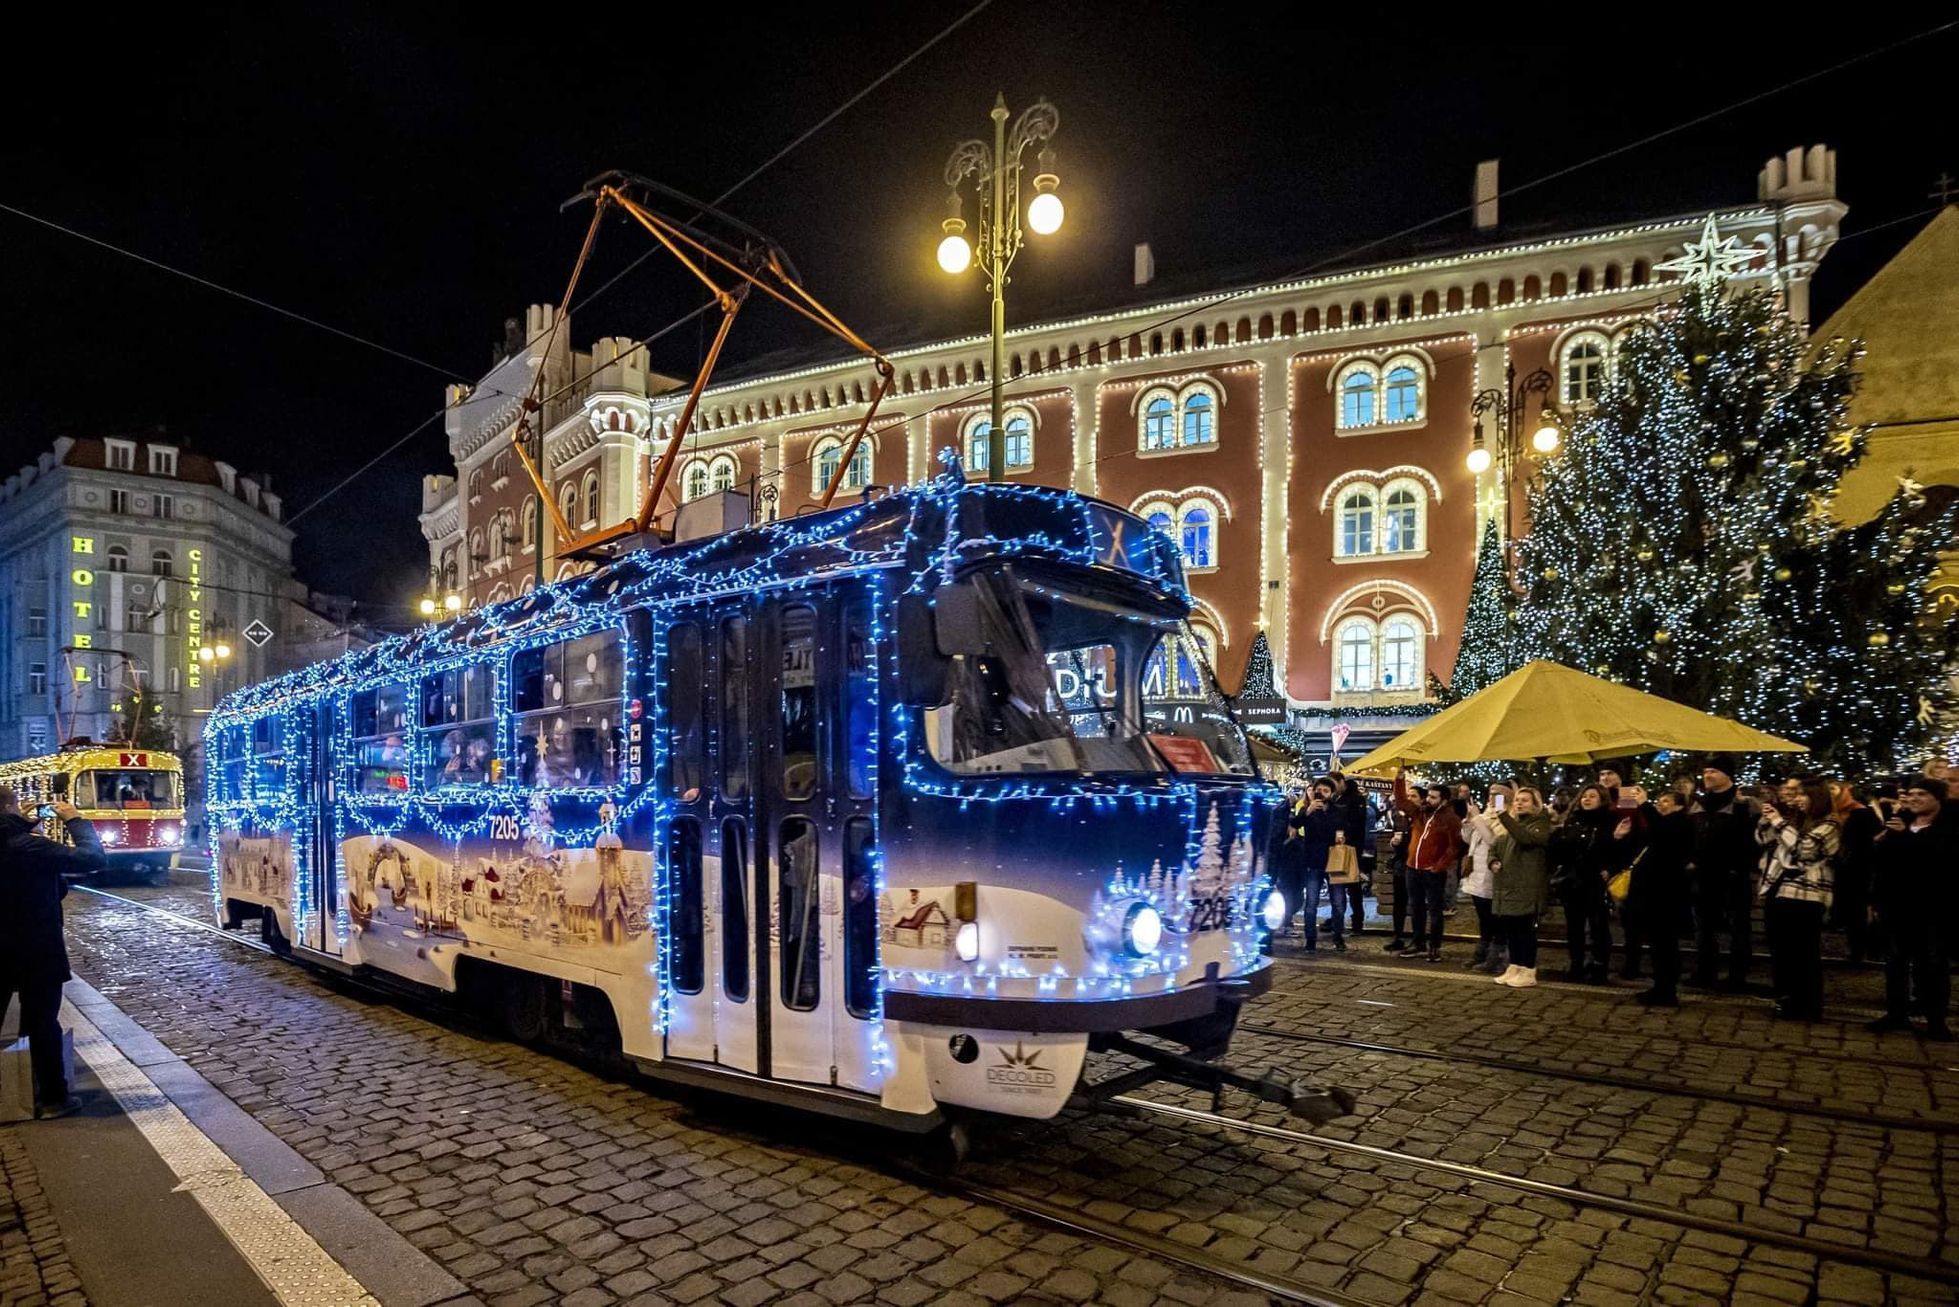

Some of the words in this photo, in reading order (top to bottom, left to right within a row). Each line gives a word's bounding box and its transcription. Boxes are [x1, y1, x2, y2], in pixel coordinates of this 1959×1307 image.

[188, 550, 201, 601] CITY
[72, 536, 94, 682] HOTEL
[188, 609, 201, 688] CENTRE
[127, 754, 140, 766] X
[489, 815, 519, 840] 7205
[986, 1068, 1056, 1085] DECOLED
